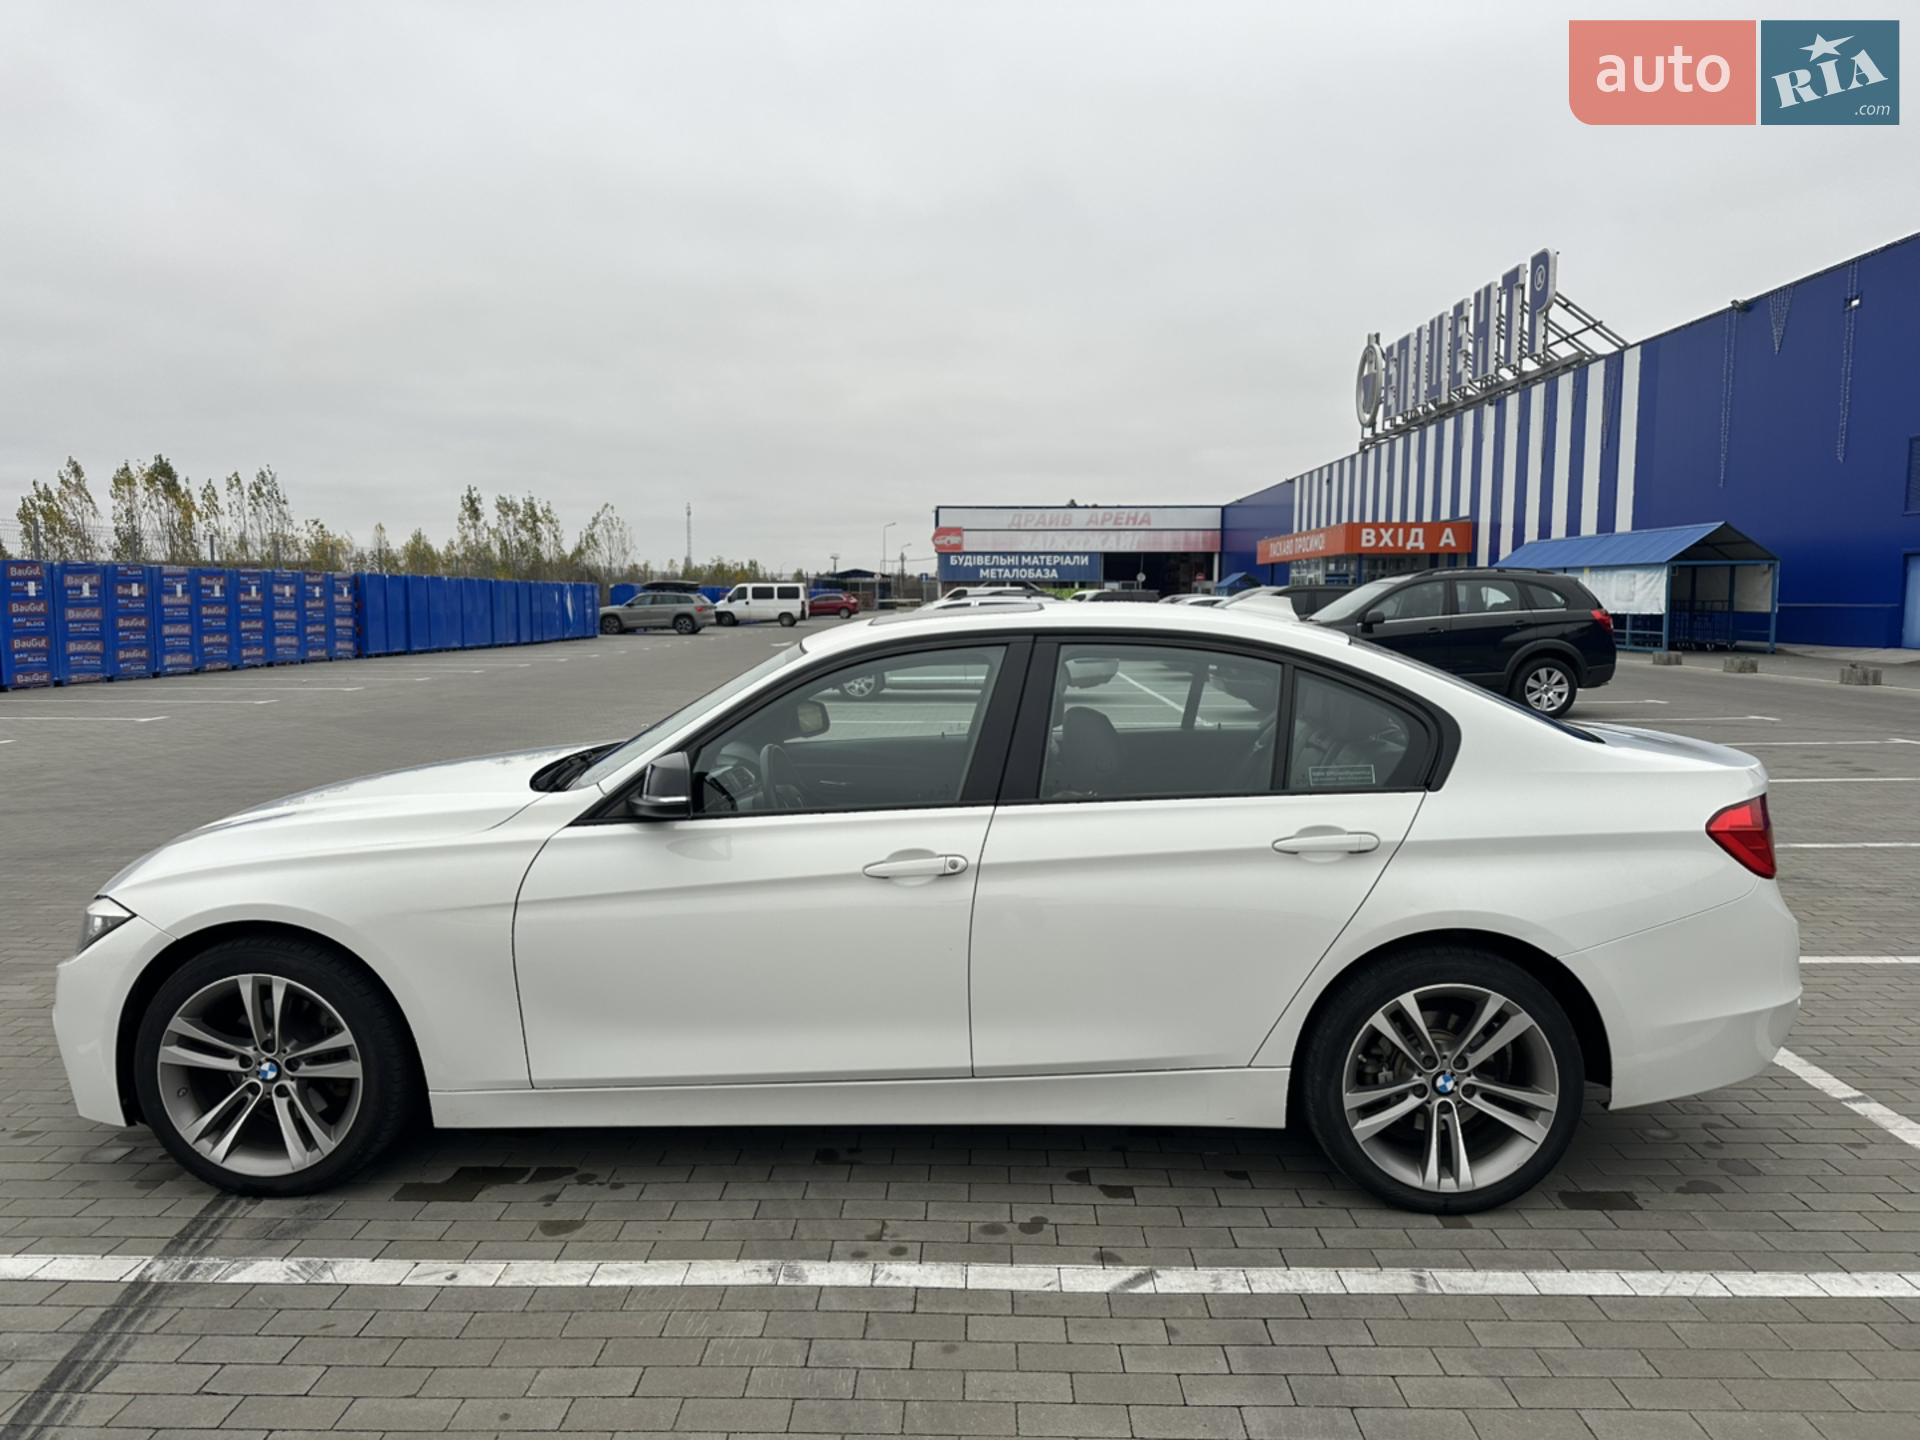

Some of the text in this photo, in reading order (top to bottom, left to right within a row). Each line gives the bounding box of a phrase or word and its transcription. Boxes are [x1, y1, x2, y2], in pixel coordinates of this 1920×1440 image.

[1085, 511, 1152, 527] АРЕНА
[1361, 528, 1456, 550] ВХІД А
[950, 555, 1090, 567] БУДІВЕЛЬНІ МАТЕРІАЛИ
[10, 566, 41, 577] BauGut
[979, 567, 1059, 580] МЕТАЛОБАЗА
[11, 602, 45, 613] BauGut
[68, 609, 99, 618] BauGut
[14, 638, 46, 649] BauGut
[69, 642, 101, 652] BauGut
[16, 673, 48, 683] BauGut
